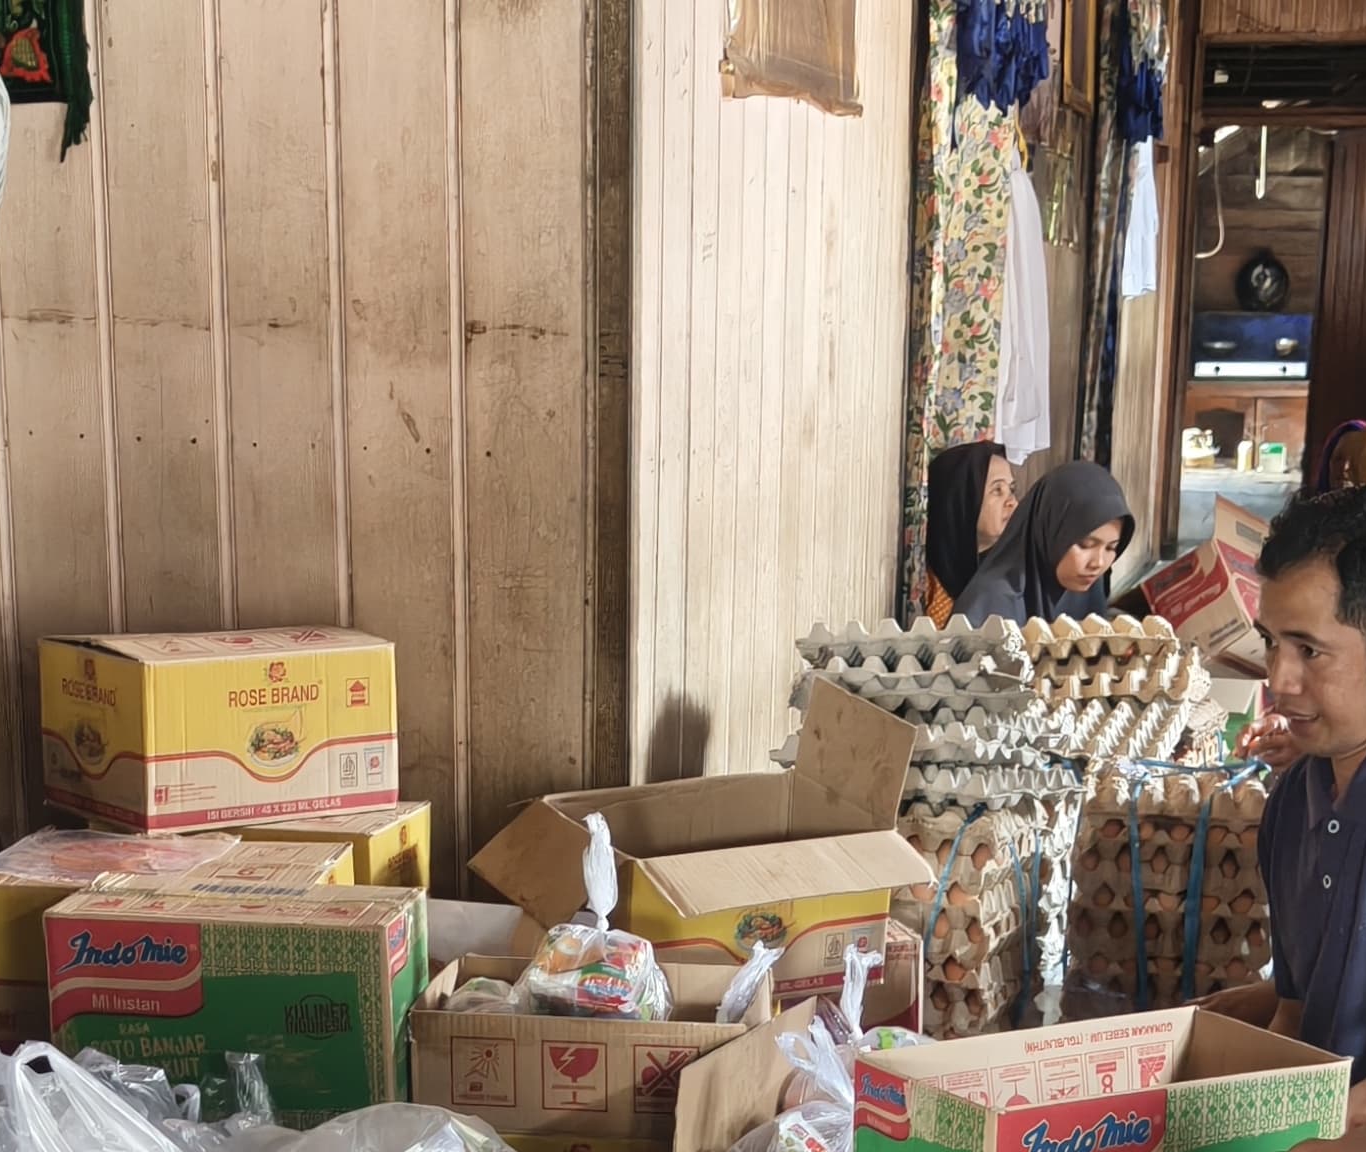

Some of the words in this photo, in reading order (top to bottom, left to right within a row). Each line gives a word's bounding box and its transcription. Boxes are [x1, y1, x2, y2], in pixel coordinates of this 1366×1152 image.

[62, 678, 85, 698] ROSE
[86, 682, 118, 707] BRAND
[227, 688, 268, 708] ROSE
[270, 684, 320, 706] BRAND
[113, 993, 161, 1012] Instan
[118, 1022, 151, 1036] RASA
[1089, 1027, 1130, 1043] SEBELUM
[1131, 1022, 1173, 1038] GUNAKAN
[140, 1033, 207, 1058] BANJAR
